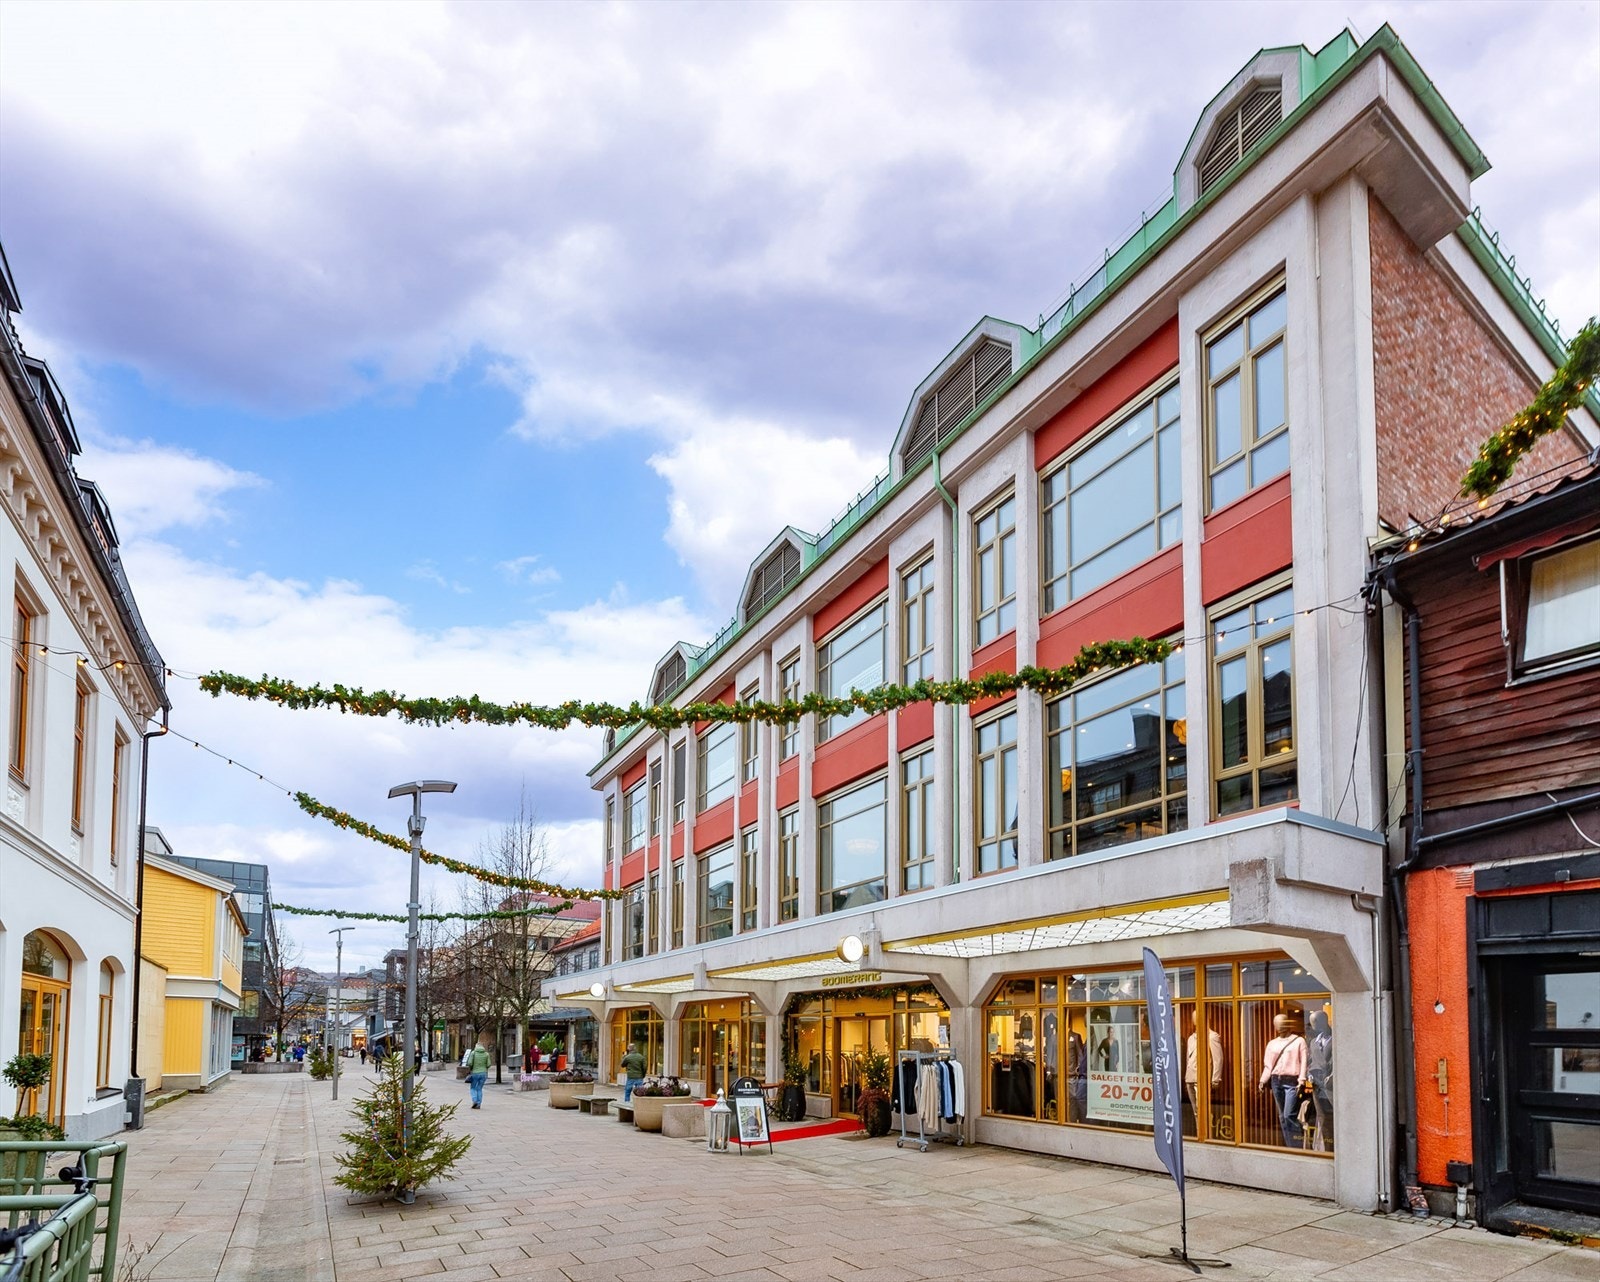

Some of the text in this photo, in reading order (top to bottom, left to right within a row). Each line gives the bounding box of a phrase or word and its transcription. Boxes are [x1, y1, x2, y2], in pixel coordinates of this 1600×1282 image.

[822, 972, 881, 986] BOOMERANG
[1091, 1074, 1123, 1082] SALGET
[1100, 1084, 1153, 1102] 20-70
